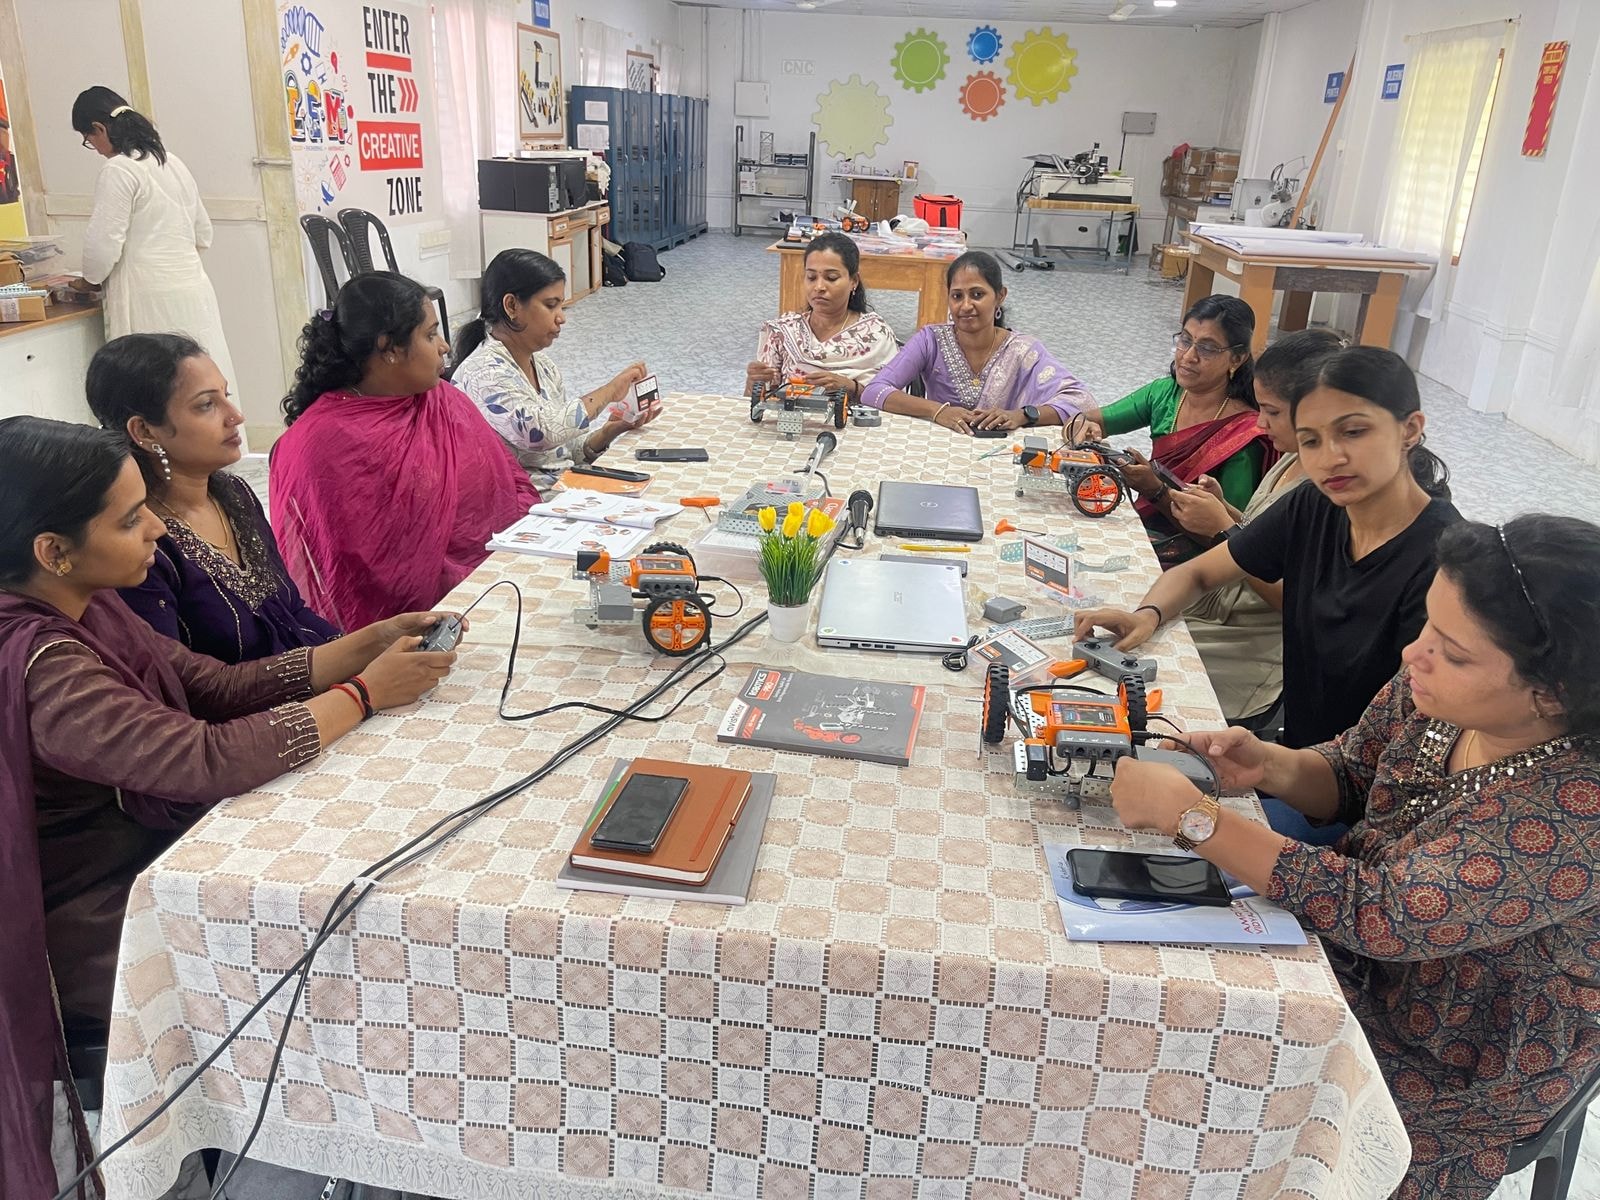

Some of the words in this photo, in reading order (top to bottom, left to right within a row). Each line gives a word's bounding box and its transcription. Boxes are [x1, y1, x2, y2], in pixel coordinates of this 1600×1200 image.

[363, 6, 411, 55] ENTER
[784, 61, 814, 74] CNC
[367, 72, 397, 114] THE
[360, 132, 420, 160] CREATIVE
[386, 176, 423, 216] ZONE
